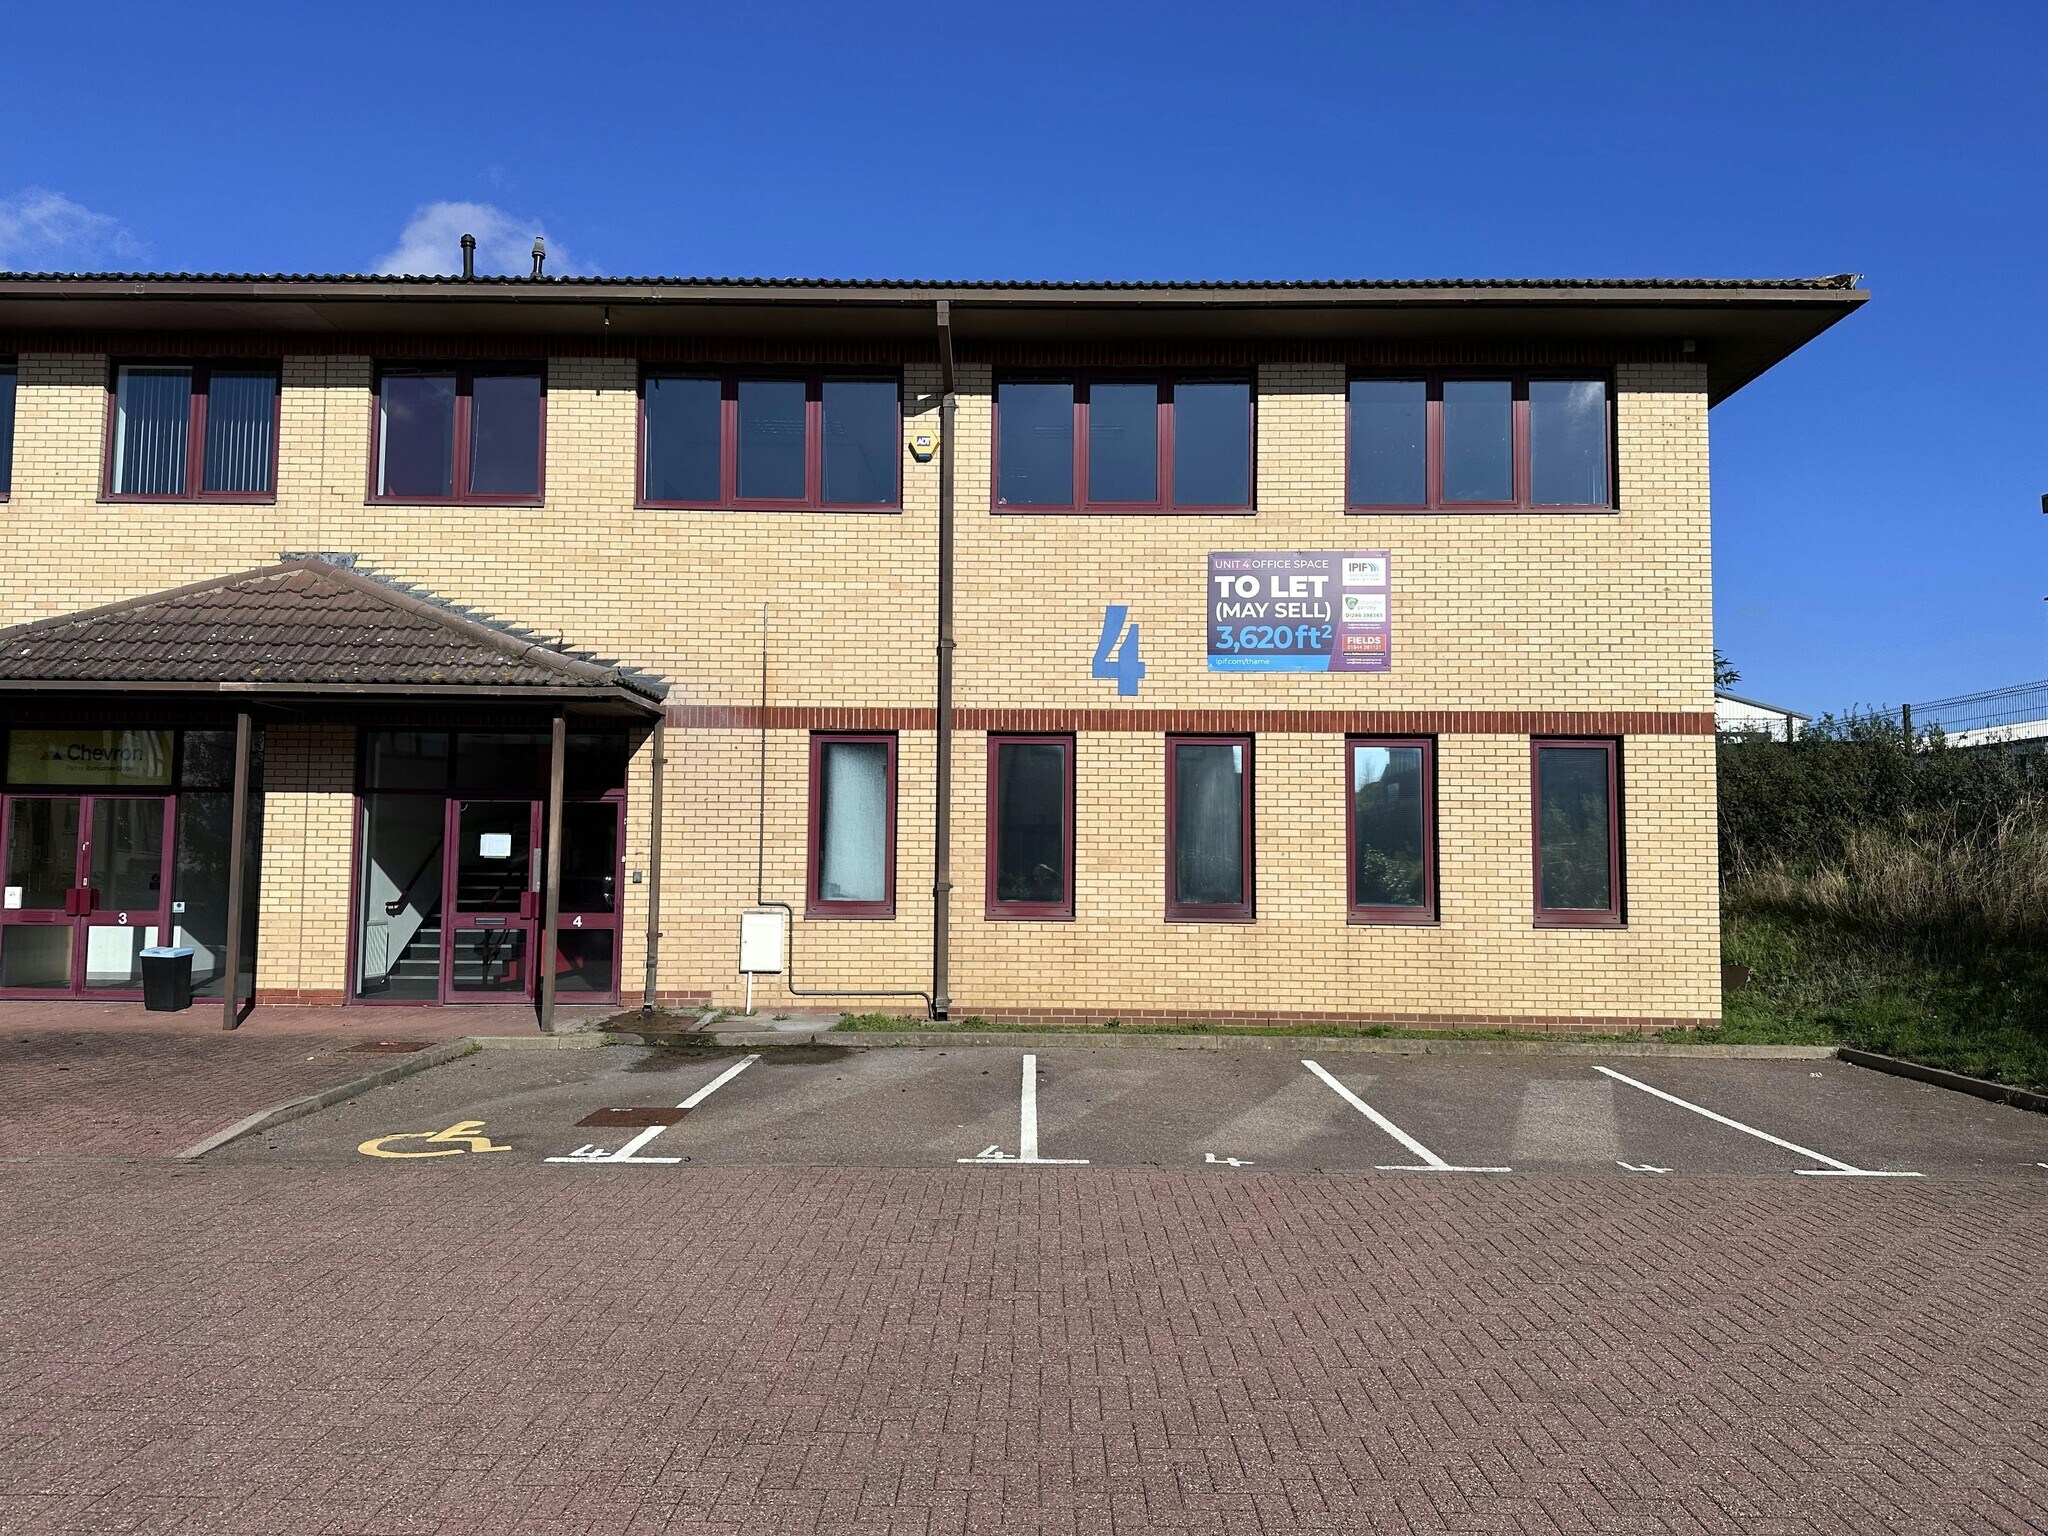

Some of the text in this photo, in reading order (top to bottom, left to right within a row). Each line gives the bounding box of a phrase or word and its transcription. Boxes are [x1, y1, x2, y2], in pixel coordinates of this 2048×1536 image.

[1215, 559, 1329, 569] UNIT 4 OFFICE SPACE
[1349, 563, 1368, 572] IPIF
[1214, 575, 1329, 599] TO LET
[1216, 602, 1331, 621] (MAY SELL)
[1347, 636, 1381, 645] FIELDS
[1092, 605, 1145, 696] 4
[67, 743, 143, 761] Chevron
[118, 912, 127, 924] 3
[573, 915, 583, 928] 4
[568, 1144, 611, 1158] 4
[976, 1145, 1015, 1159] 4
[1205, 1153, 1254, 1167] 4
